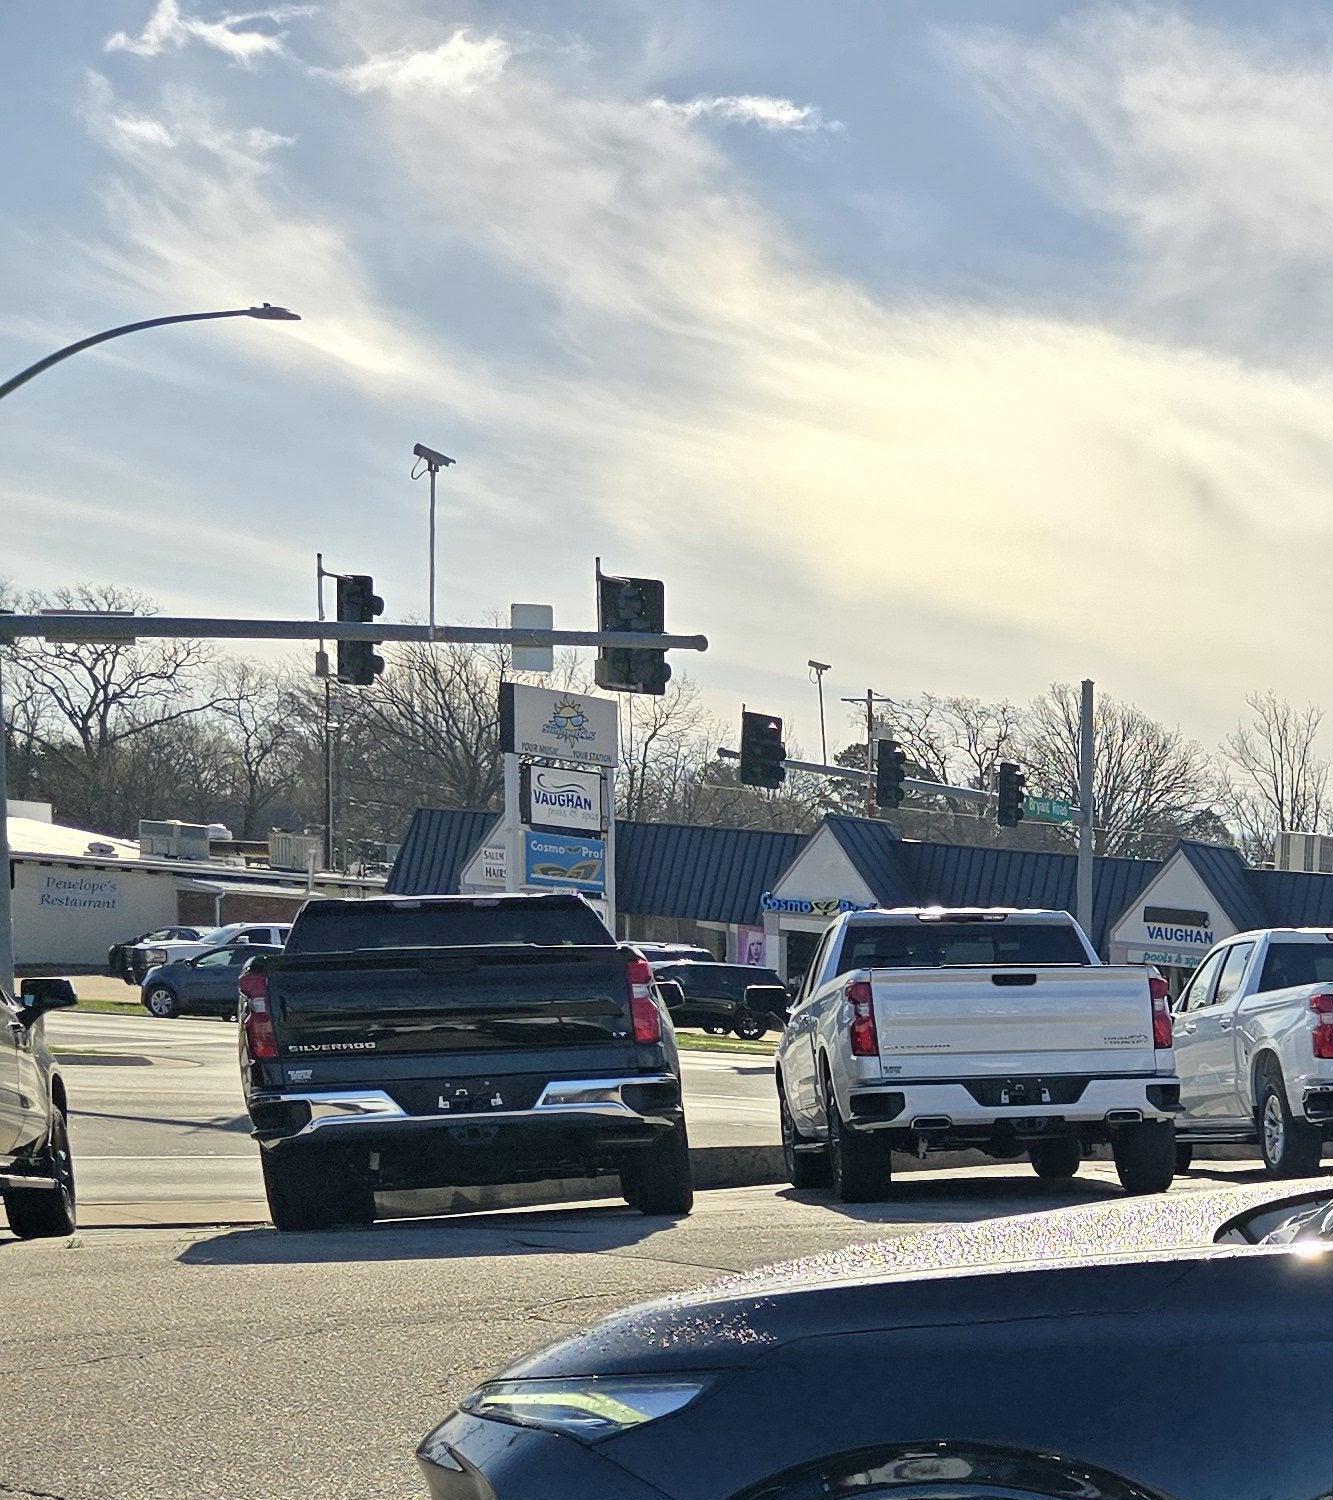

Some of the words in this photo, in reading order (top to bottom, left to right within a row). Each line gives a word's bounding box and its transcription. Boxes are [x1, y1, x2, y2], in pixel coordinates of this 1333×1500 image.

[533, 789, 592, 810] VAUGHAN
[530, 840, 565, 855] Cosmo
[581, 846, 604, 860] Prof
[46, 877, 117, 894] Penelope's
[39, 893, 116, 909] Restaurant
[761, 891, 811, 913] Cosmo
[1146, 926, 1213, 944] VAUGHAN
[1143, 951, 1172, 963] pools
[288, 1042, 376, 1052] SILVERADO
